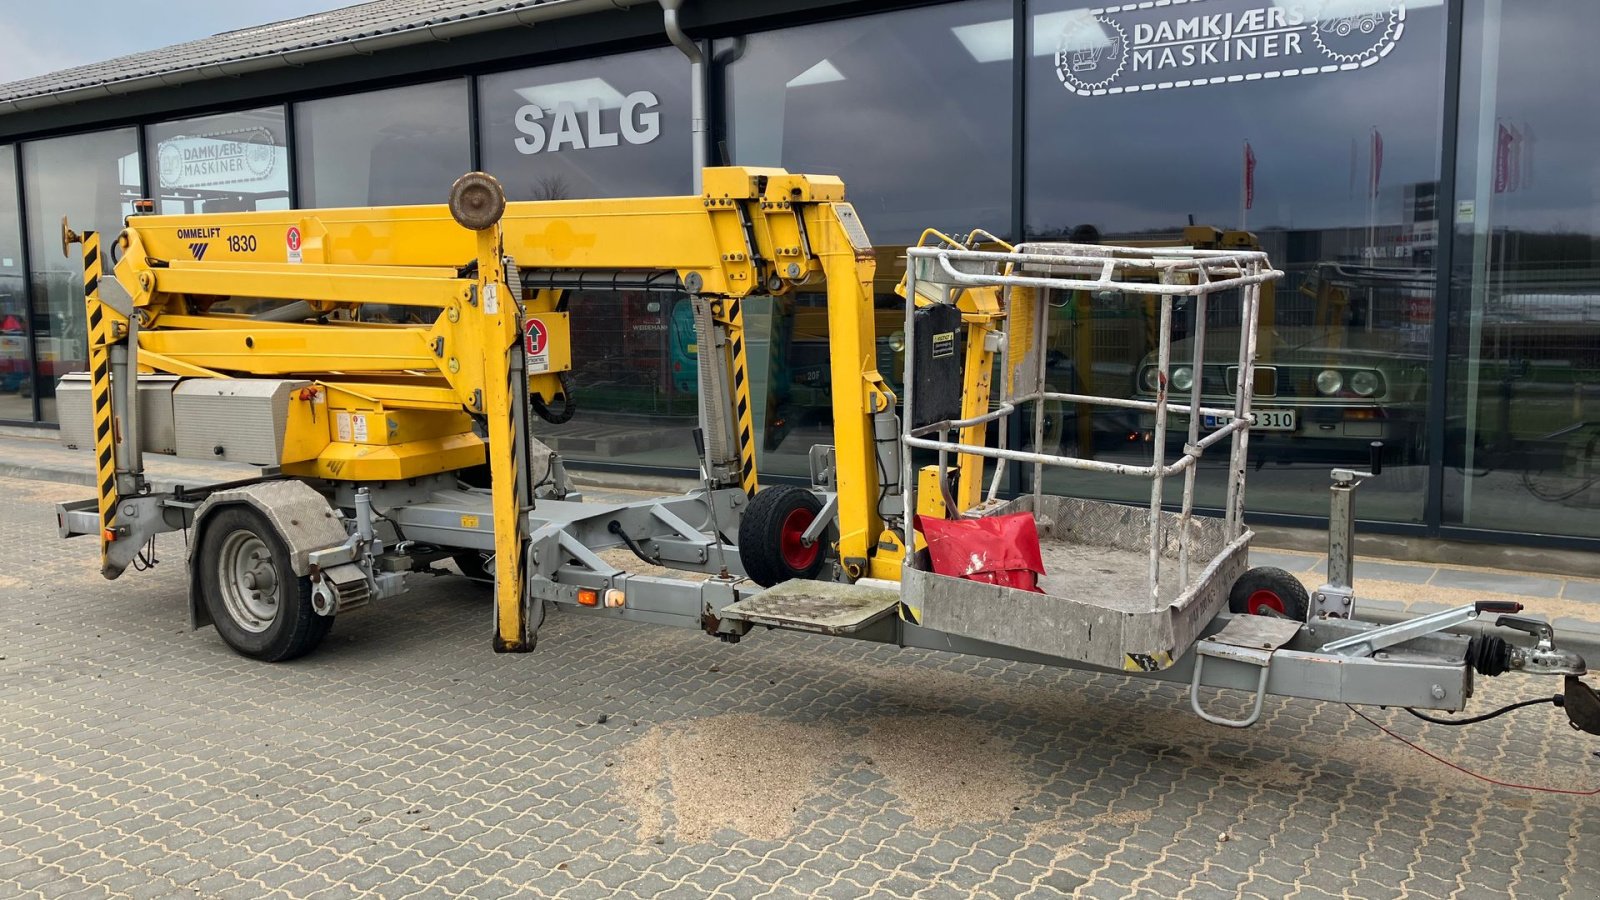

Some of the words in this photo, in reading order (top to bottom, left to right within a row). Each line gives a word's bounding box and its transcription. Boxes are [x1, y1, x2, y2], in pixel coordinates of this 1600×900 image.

[1134, 6, 1304, 45] DAMKJÆRS
[1133, 32, 1302, 71] MASKINER
[514, 90, 660, 155] SALG
[184, 142, 243, 160] DAMKJÆRS
[184, 159, 243, 176] MASKINER
[177, 228, 220, 239] OMMELIFT
[227, 235, 258, 252] 1830
[1263, 413, 1292, 427] 310
